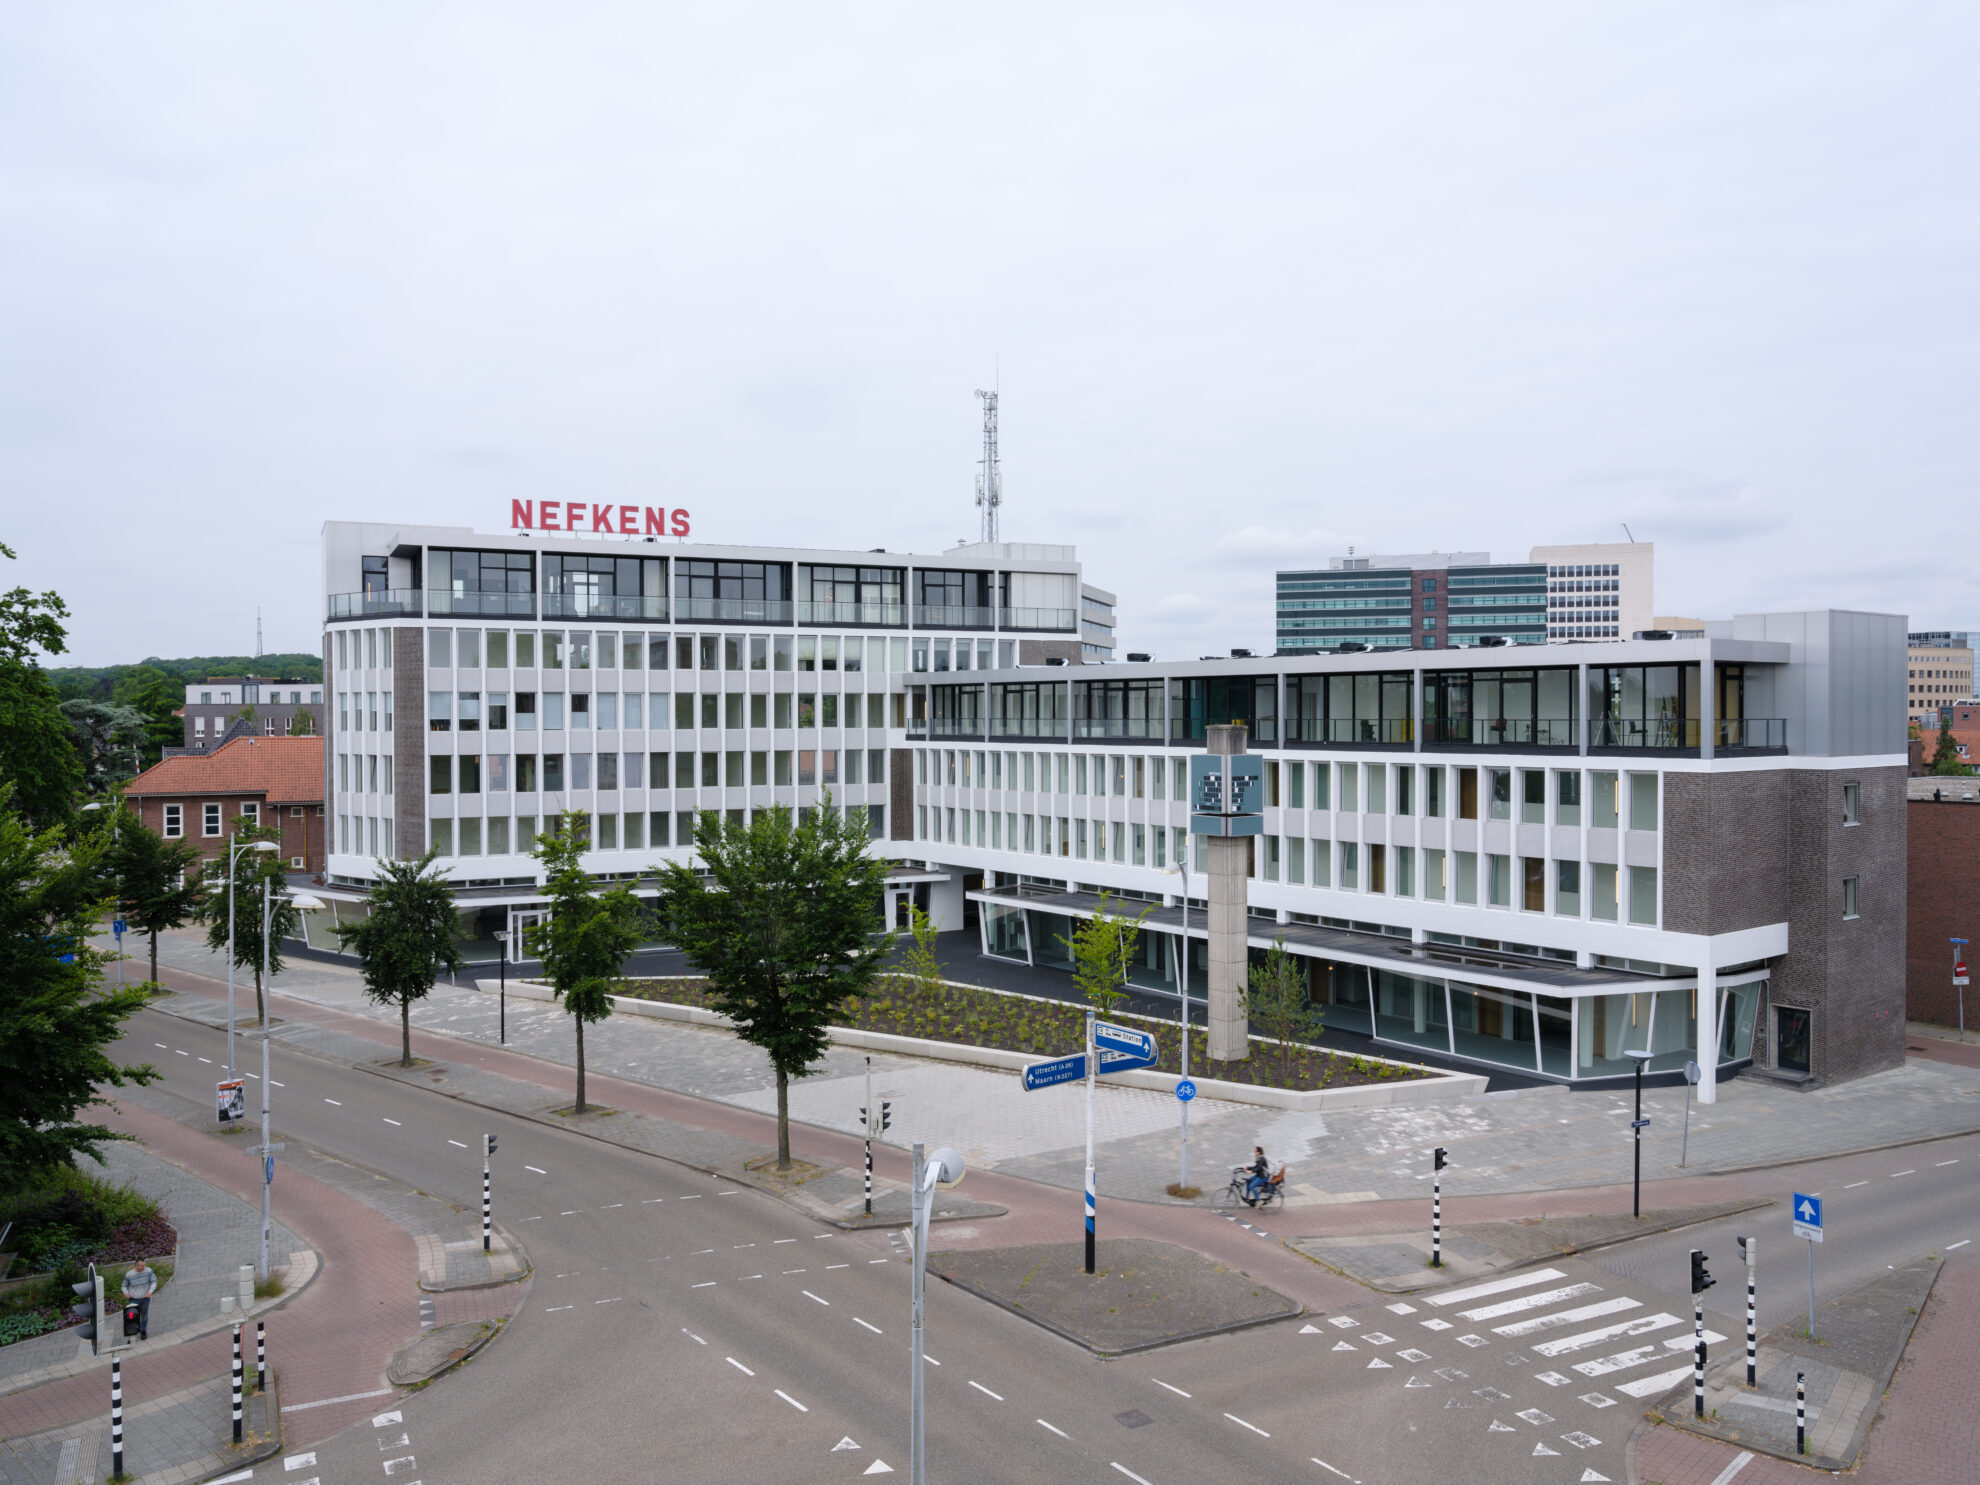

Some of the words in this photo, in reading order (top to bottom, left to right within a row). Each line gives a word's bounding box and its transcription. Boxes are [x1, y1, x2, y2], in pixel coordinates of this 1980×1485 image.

[511, 498, 690, 537] NEFKENS
[1122, 1032, 1142, 1044] Station
[1035, 1065, 1057, 1075] Utrecht
[1035, 1076, 1054, 1084] Maarn
